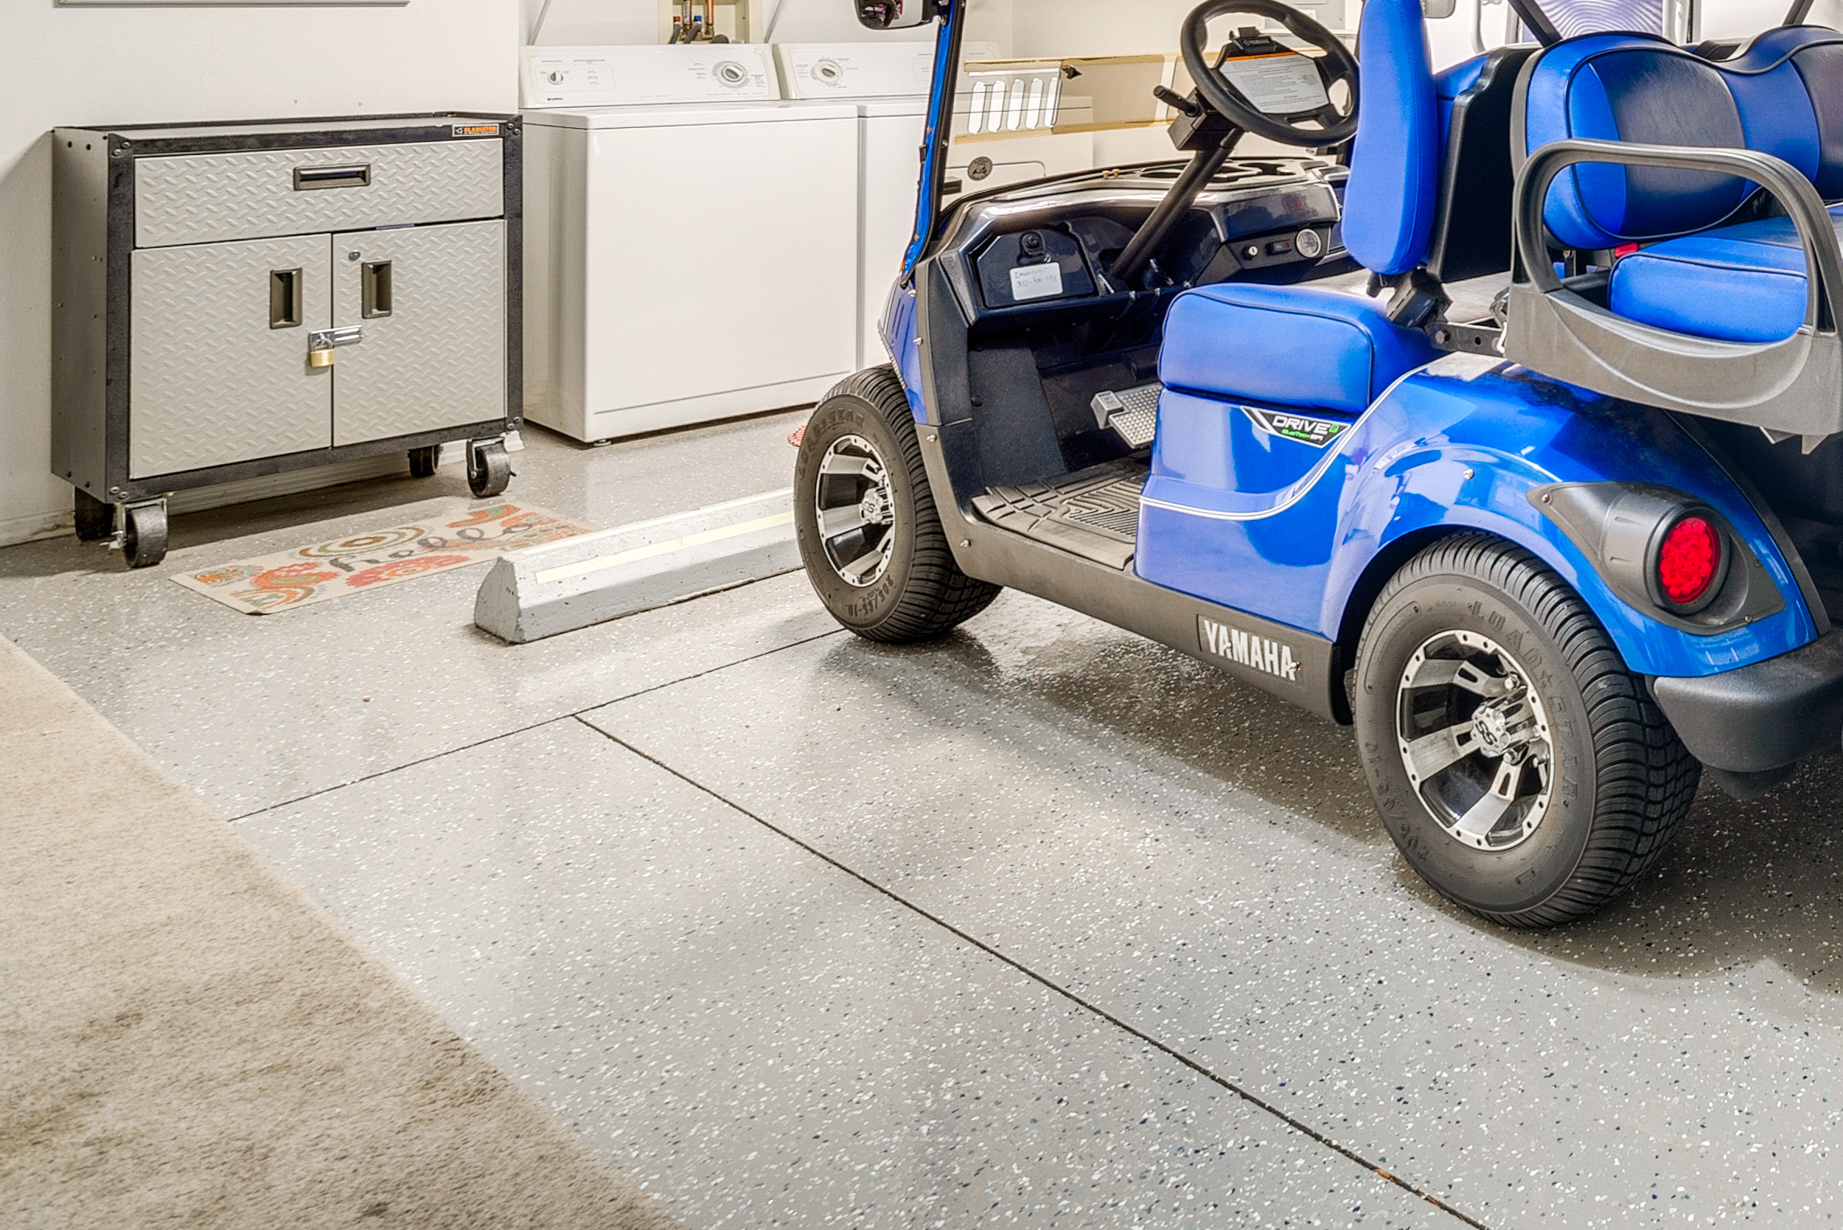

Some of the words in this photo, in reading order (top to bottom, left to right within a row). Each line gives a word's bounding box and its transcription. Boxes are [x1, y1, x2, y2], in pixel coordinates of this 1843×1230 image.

[1272, 415, 1331, 435] DRIVE
[1203, 619, 1297, 682] YAMAHA
[1547, 696, 1579, 802] STAR
